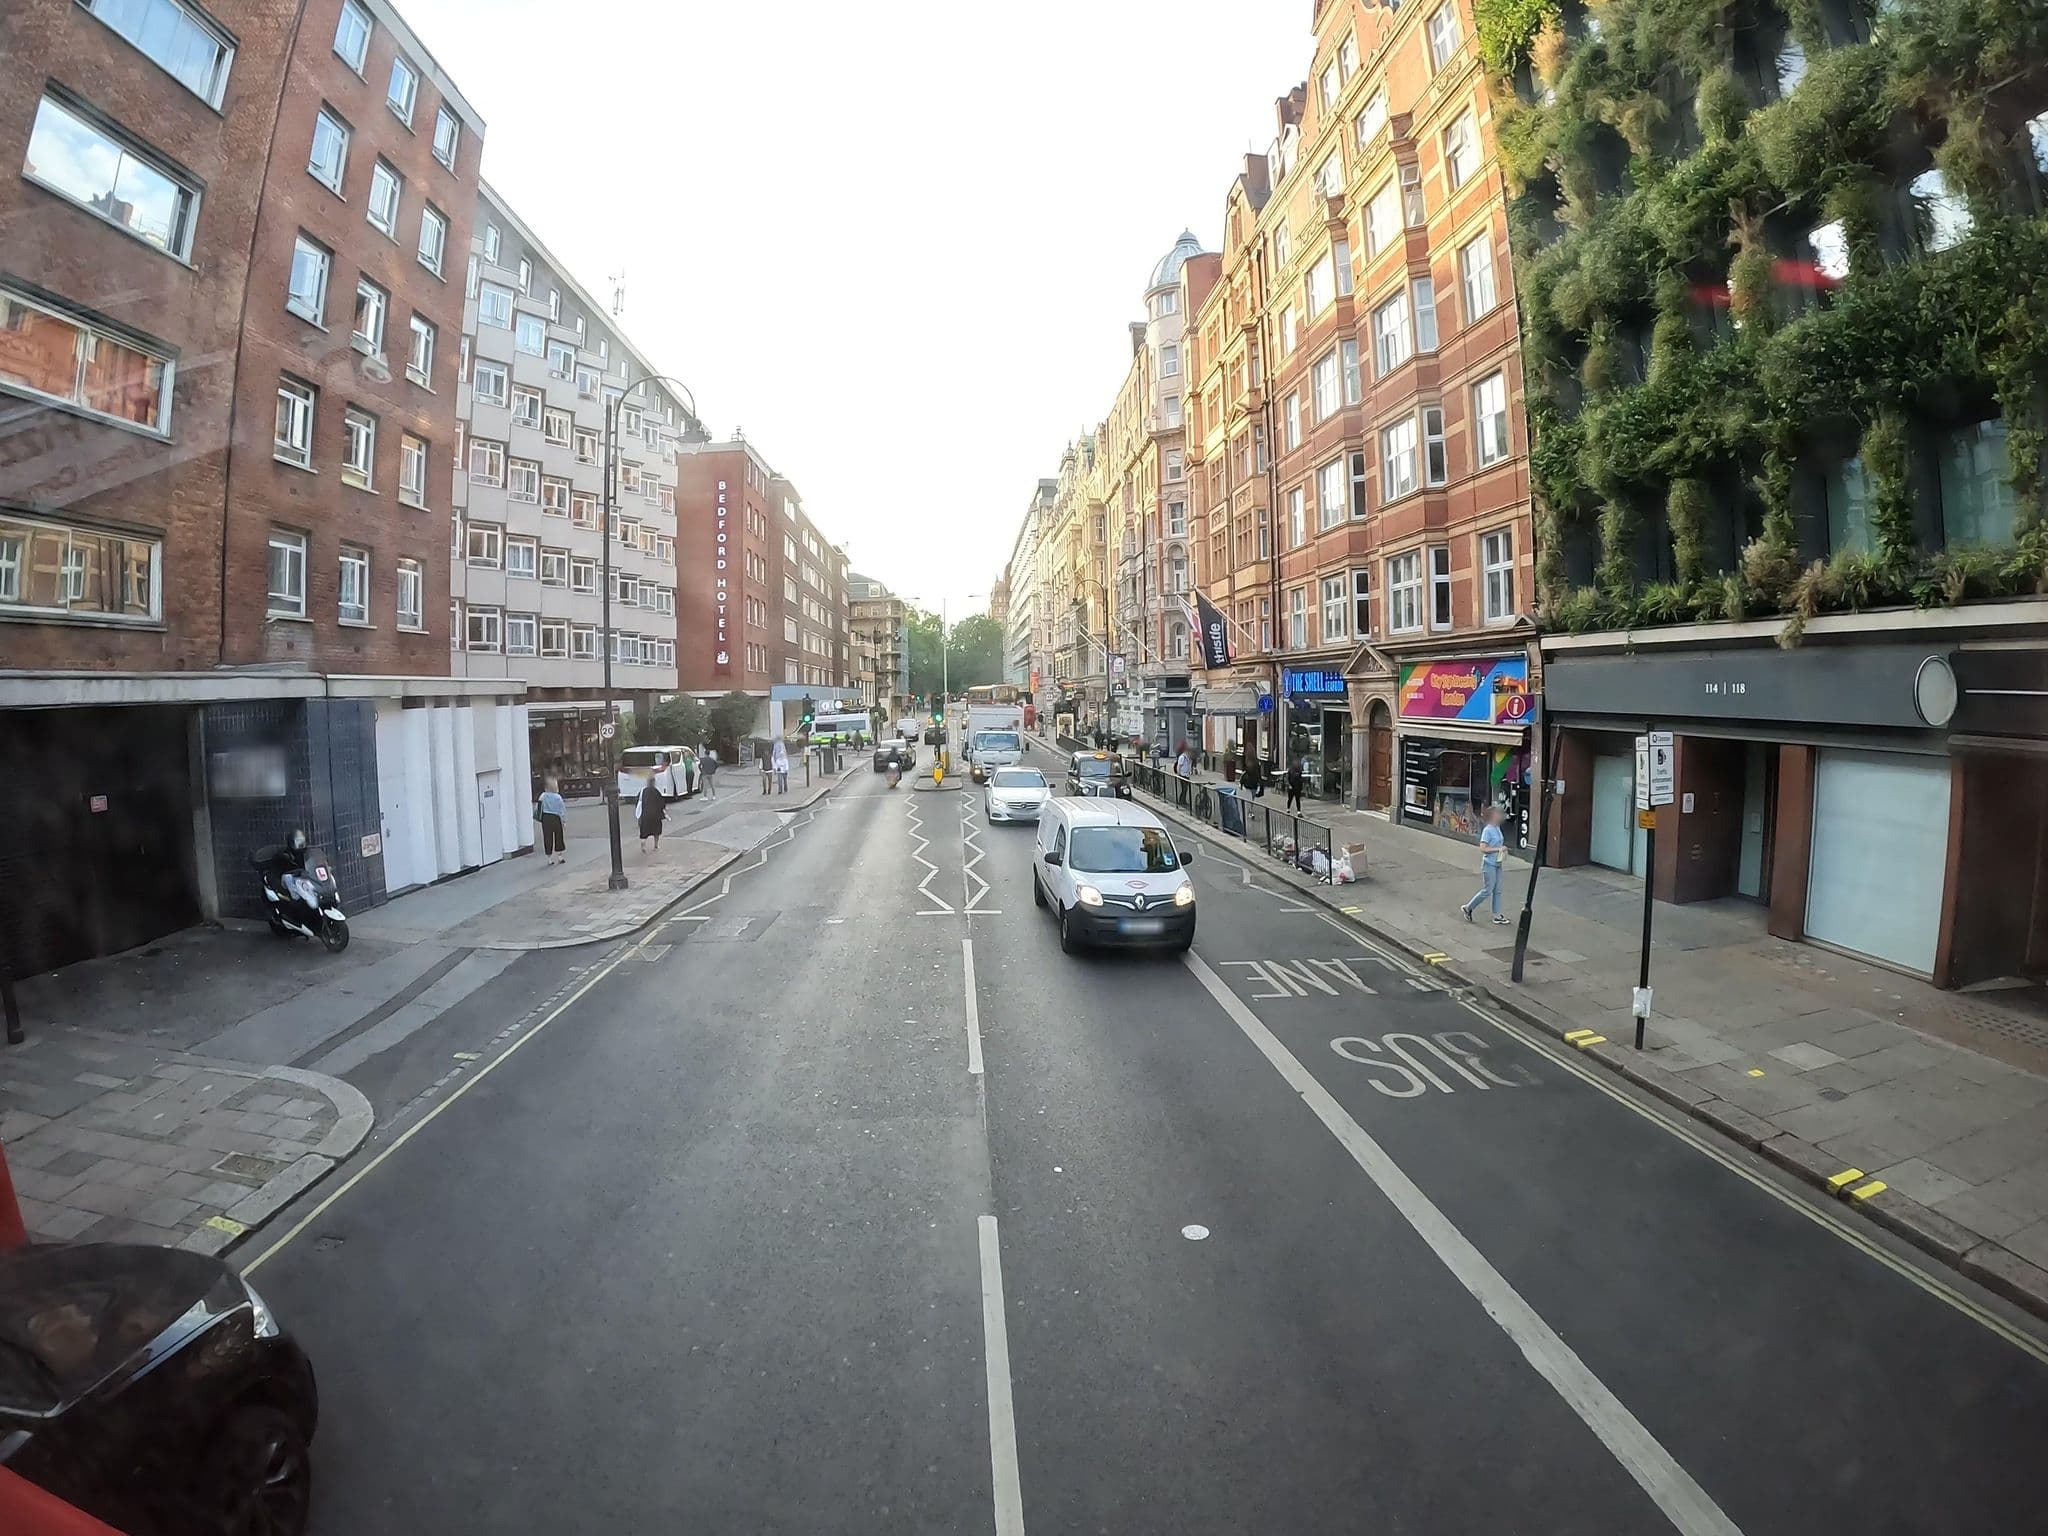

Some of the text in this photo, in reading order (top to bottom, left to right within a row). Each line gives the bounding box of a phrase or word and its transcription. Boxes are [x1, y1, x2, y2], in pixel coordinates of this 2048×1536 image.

[716, 480, 727, 642] BEDFORD HOTEL
[1208, 622, 1225, 664] thistle
[1292, 673, 1304, 691] THE
[1304, 671, 1325, 691] SHELL
[1705, 683, 1718, 693] 114
[1732, 683, 1746, 694] 118
[1441, 690, 1466, 706] London
[602, 727, 614, 735] 20
[1219, 956, 1432, 999] LANE
[1329, 1031, 1544, 1098] BUS
